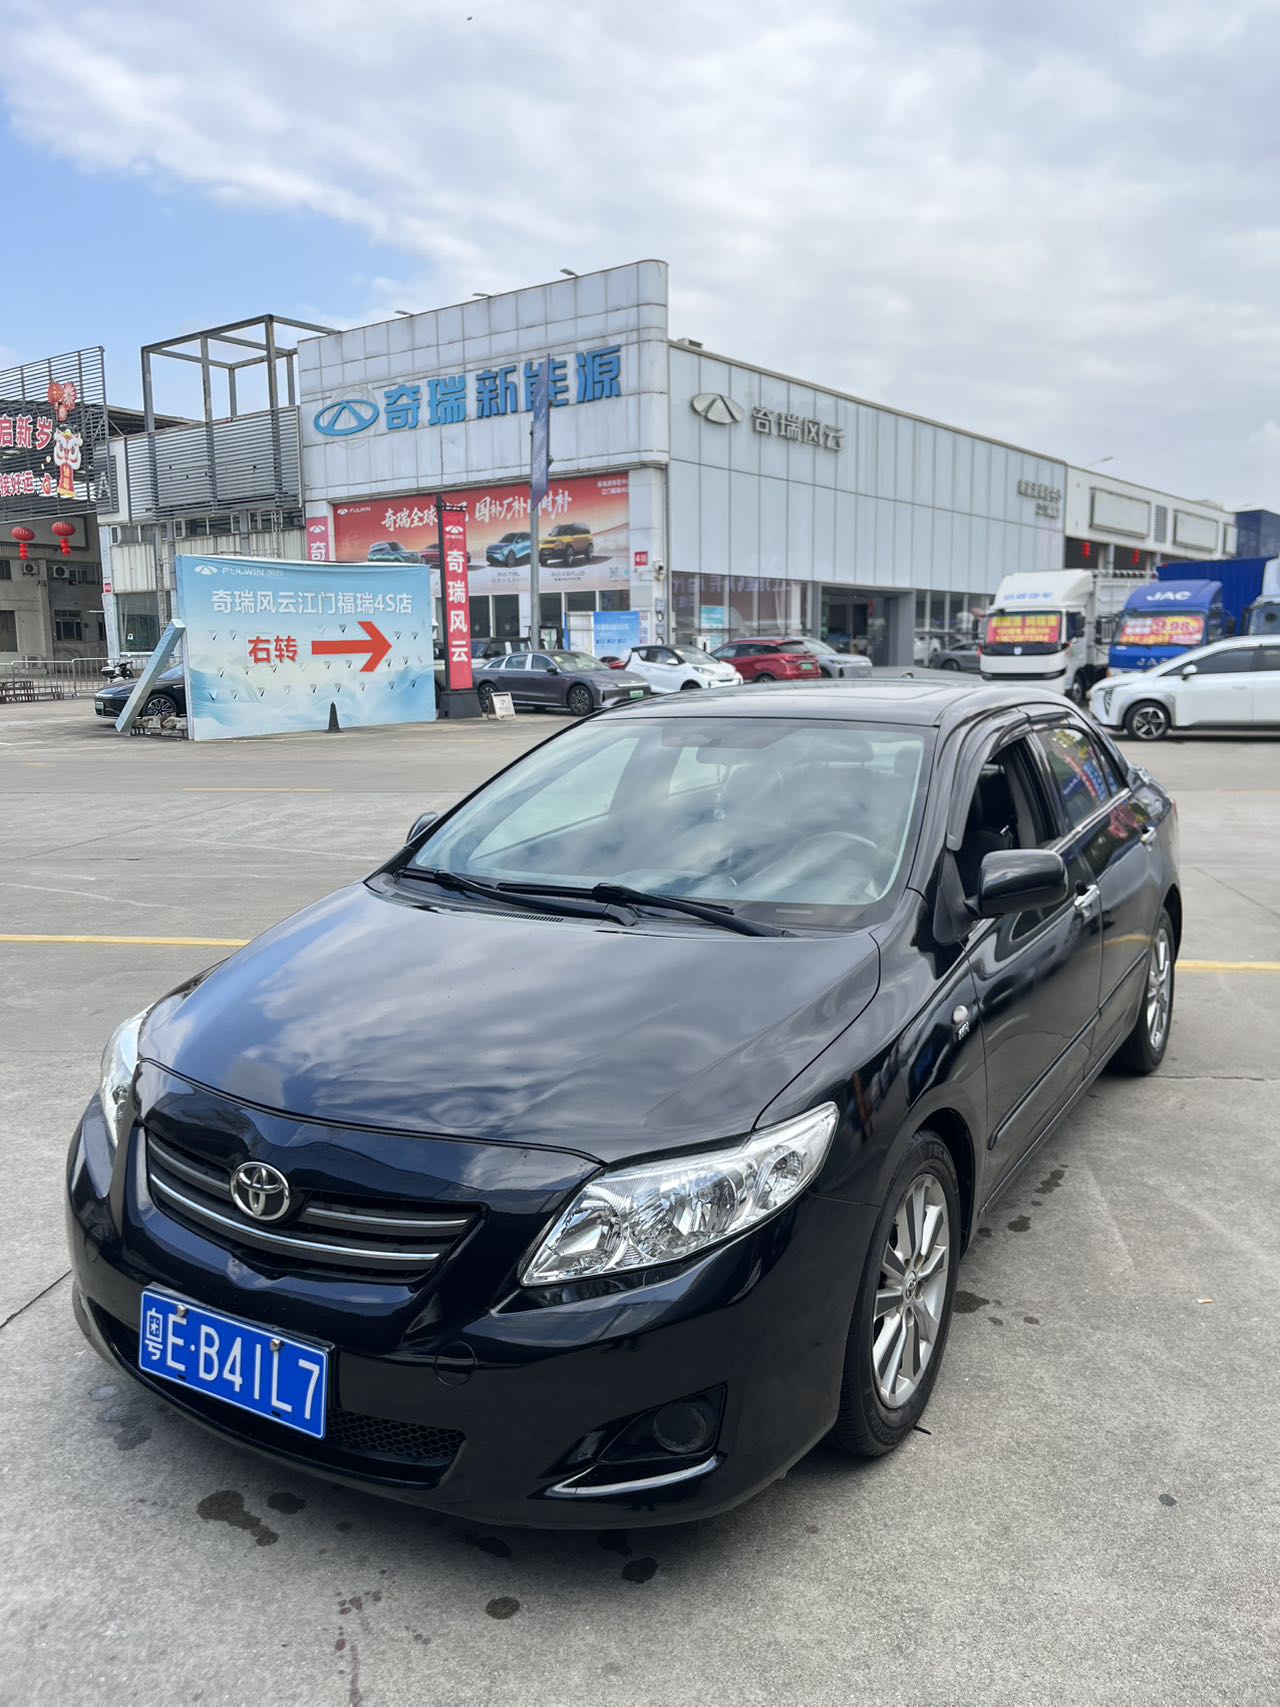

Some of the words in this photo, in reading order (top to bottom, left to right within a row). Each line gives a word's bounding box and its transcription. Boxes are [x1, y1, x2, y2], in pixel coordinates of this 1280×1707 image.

[383, 344, 623, 430] 奇瑞新能源
[752, 406, 843, 450] 奇瑞风云
[222, 567, 264, 576] FULWIN
[212, 590, 413, 615] 奇瑞风云江门福瑞4S店
[447, 550, 468, 663] 奇瑞风云
[1146, 591, 1192, 601] JAC
[247, 635, 298, 664] 右转
[144, 1308, 321, 1420] 粤E·B41L7
